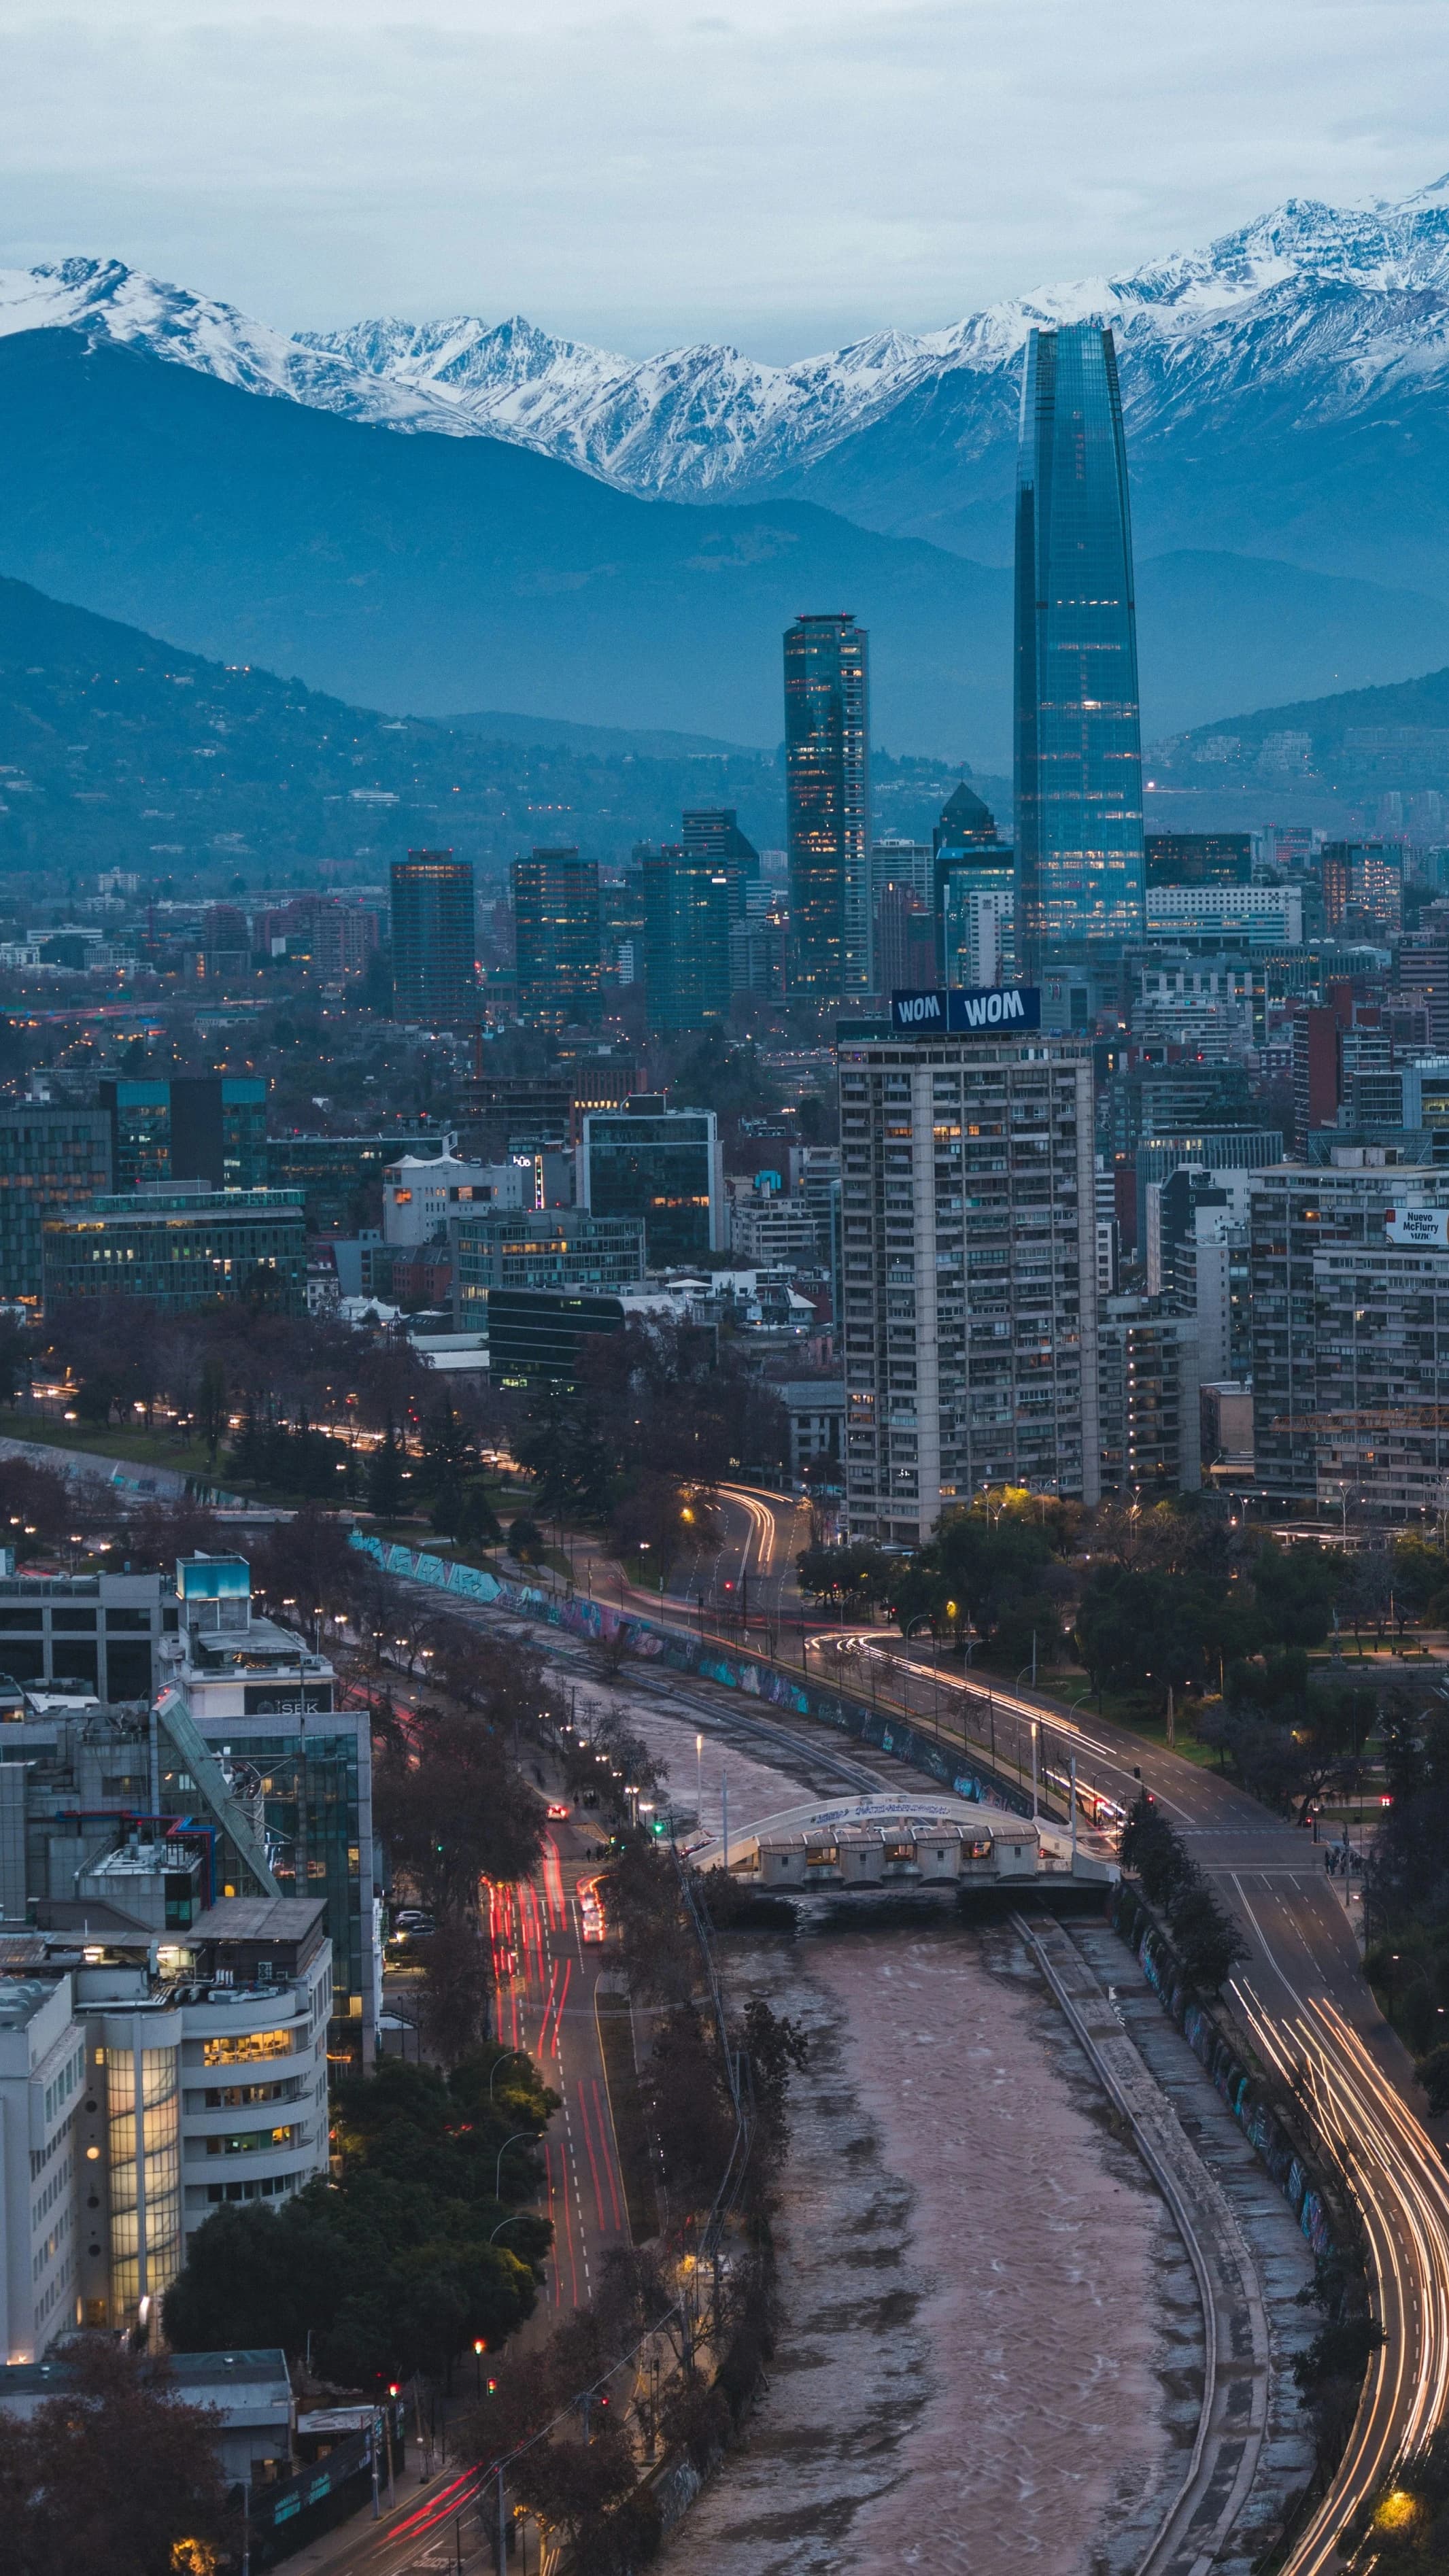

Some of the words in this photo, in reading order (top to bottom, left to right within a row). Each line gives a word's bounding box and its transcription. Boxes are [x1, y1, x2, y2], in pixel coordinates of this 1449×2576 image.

[898, 995, 940, 1023] WOM
[964, 990, 1025, 1026] WOM
[1408, 1212, 1433, 1222] Nuevo
[1403, 1222, 1439, 1234] McFlurry
